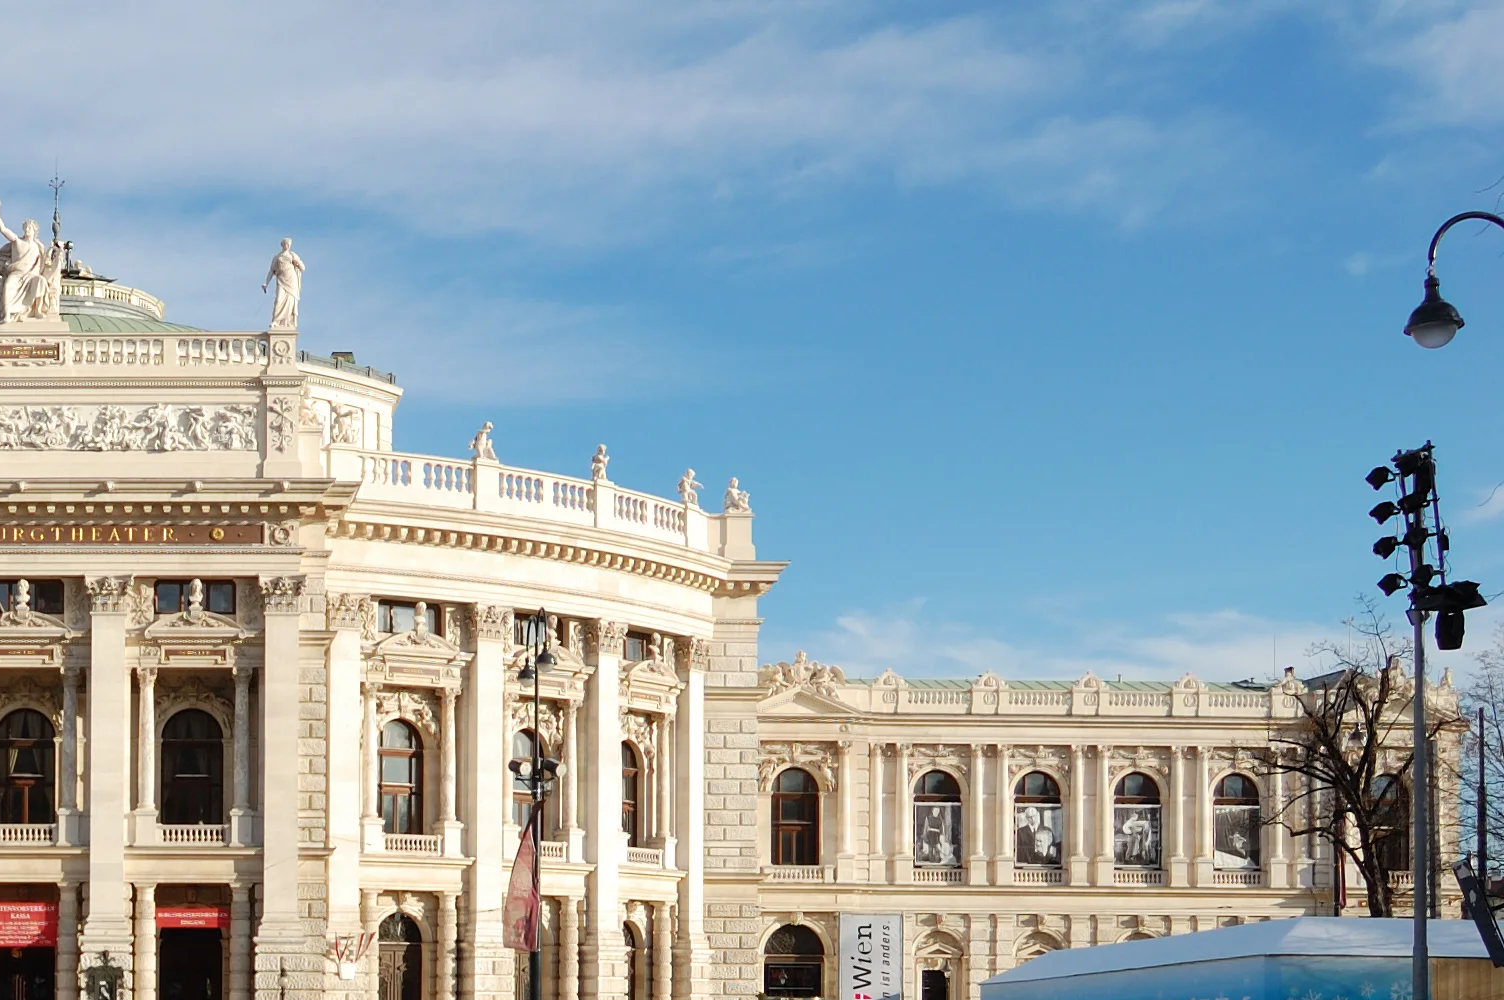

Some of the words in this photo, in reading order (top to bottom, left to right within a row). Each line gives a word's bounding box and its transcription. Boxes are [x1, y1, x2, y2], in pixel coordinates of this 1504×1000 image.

[851, 923, 872, 990] Wien
[880, 920, 891, 966] anders.
[880, 971, 891, 986] ist
